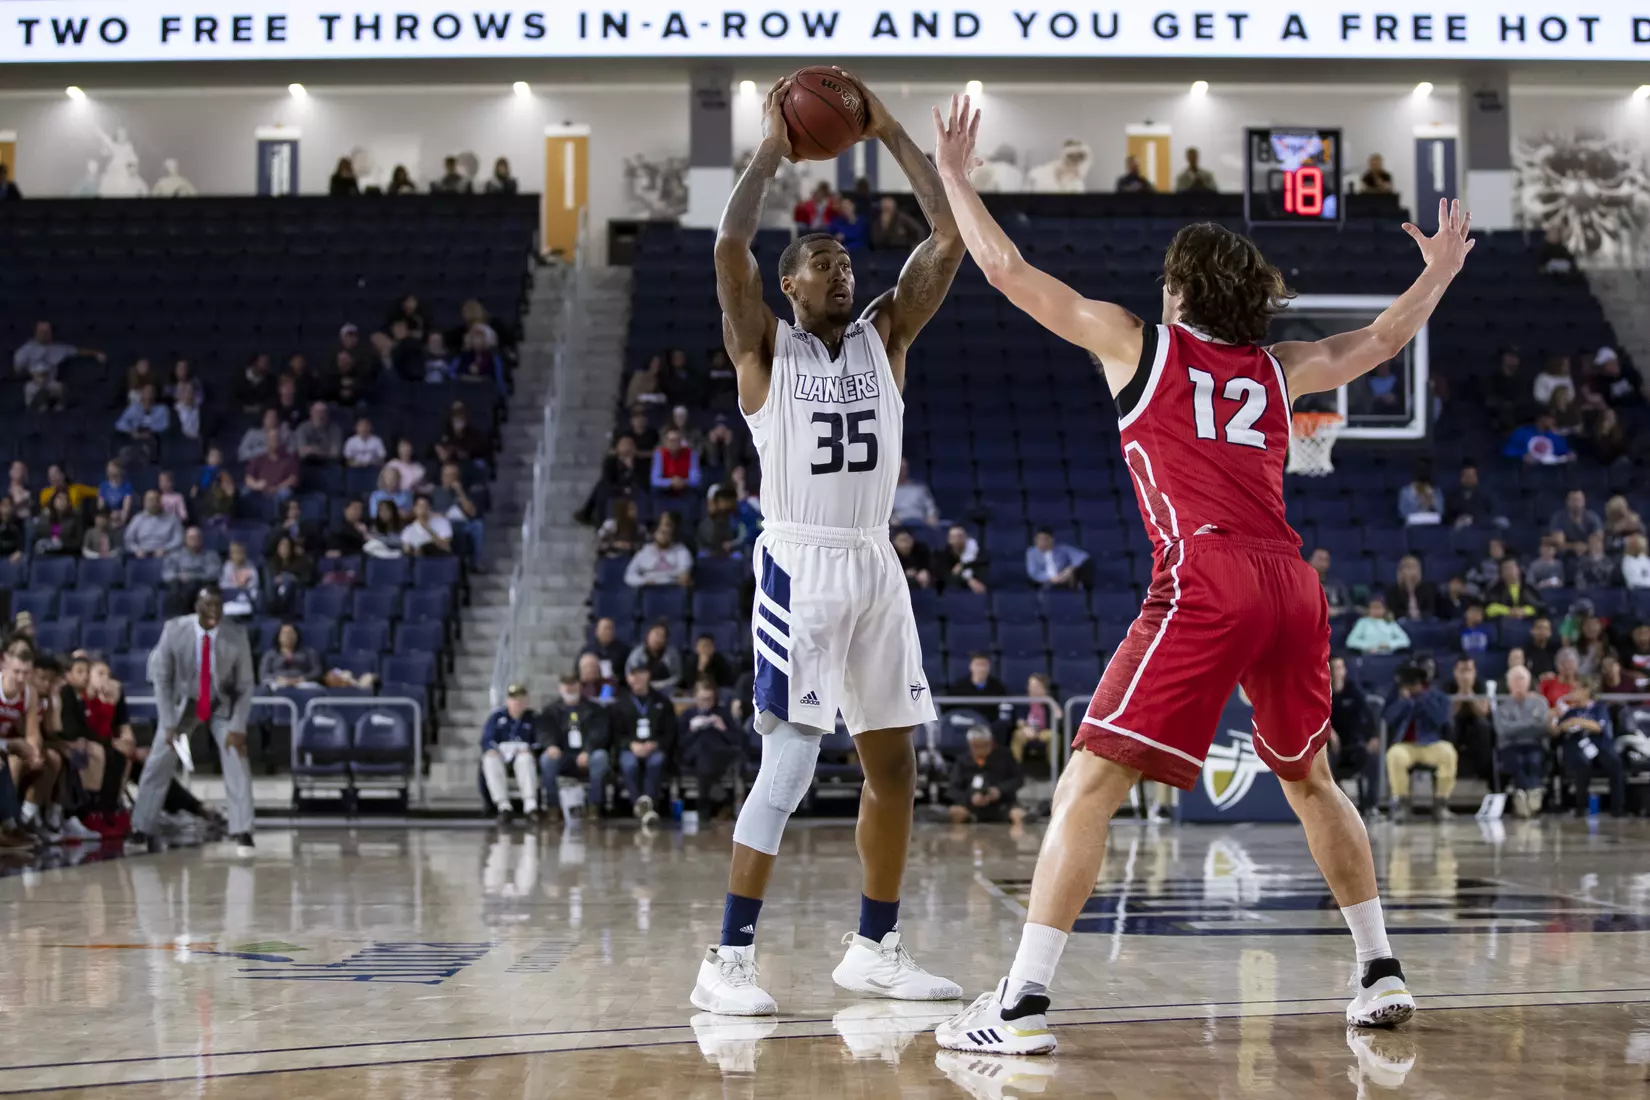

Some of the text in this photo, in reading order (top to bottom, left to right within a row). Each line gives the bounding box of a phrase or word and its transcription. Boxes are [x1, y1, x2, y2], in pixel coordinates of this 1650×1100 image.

[17, 17, 129, 46] TWO
[161, 15, 288, 43] FREE
[319, 12, 547, 41] THROWS
[579, 11, 840, 39] IN-A-ROW
[871, 12, 981, 38] AND
[1014, 12, 1120, 39] YOU
[1153, 12, 1249, 40] GET
[1281, 14, 1308, 40] A
[1341, 14, 1468, 42] FREE
[1499, 15, 1600, 43] HOT
[1283, 166, 1323, 216] 18
[1187, 366, 1269, 451] 12
[810, 409, 878, 475] 35
